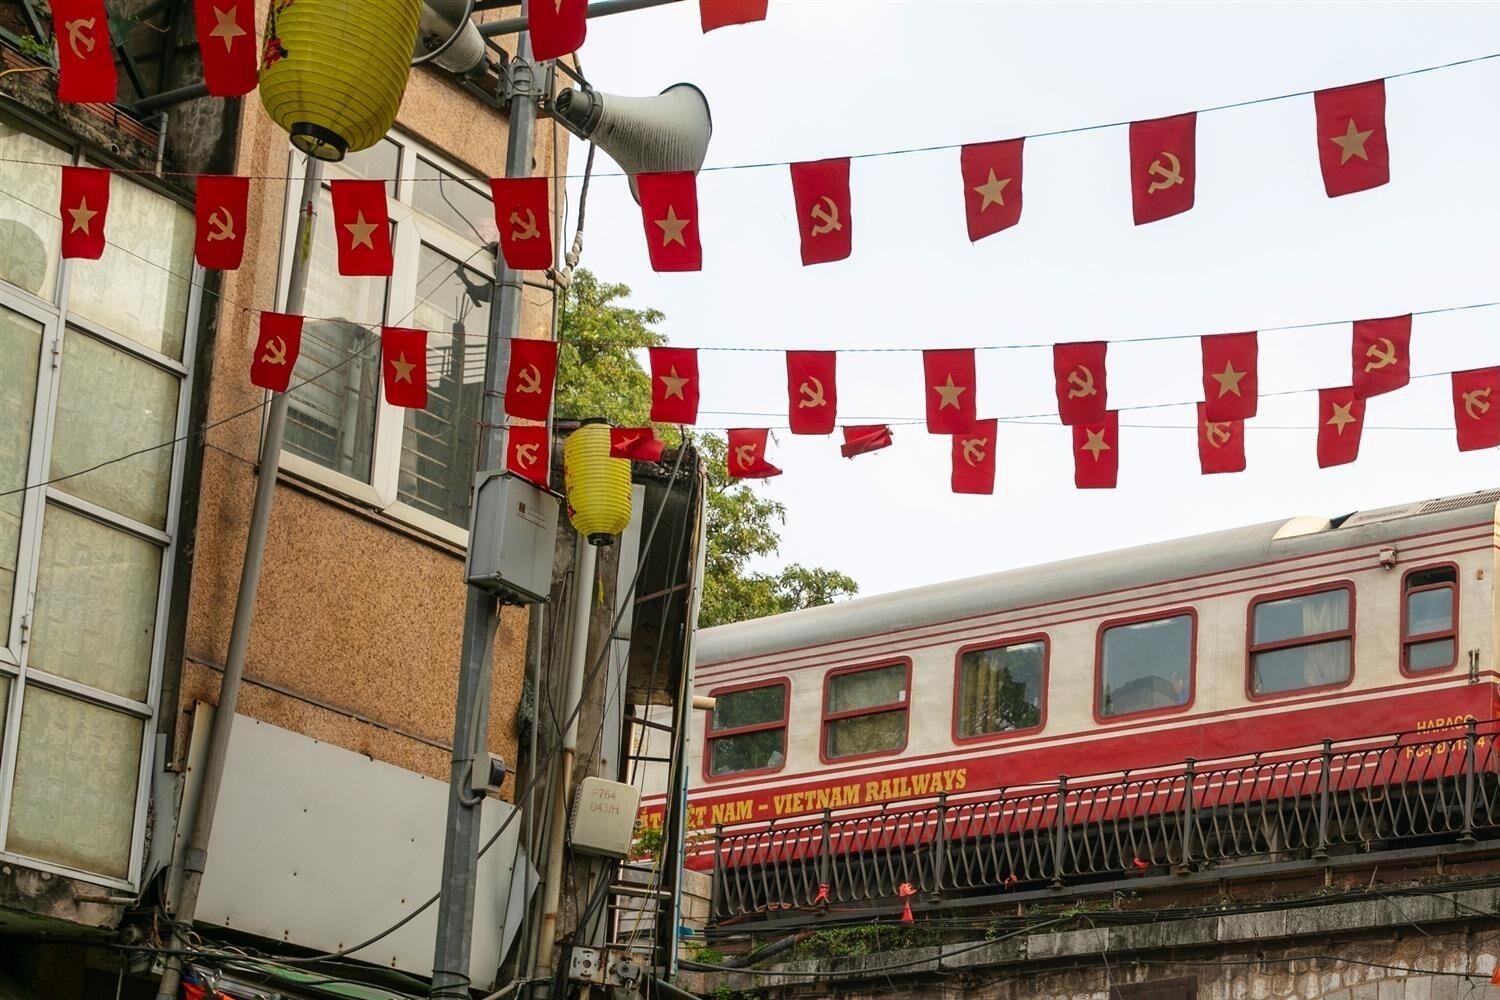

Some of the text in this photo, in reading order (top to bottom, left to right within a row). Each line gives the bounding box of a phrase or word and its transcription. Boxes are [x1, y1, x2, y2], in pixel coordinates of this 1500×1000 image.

[711, 799, 754, 825] NAM
[773, 784, 861, 815] VIETNAM
[865, 768, 967, 802] RAILWAYS
